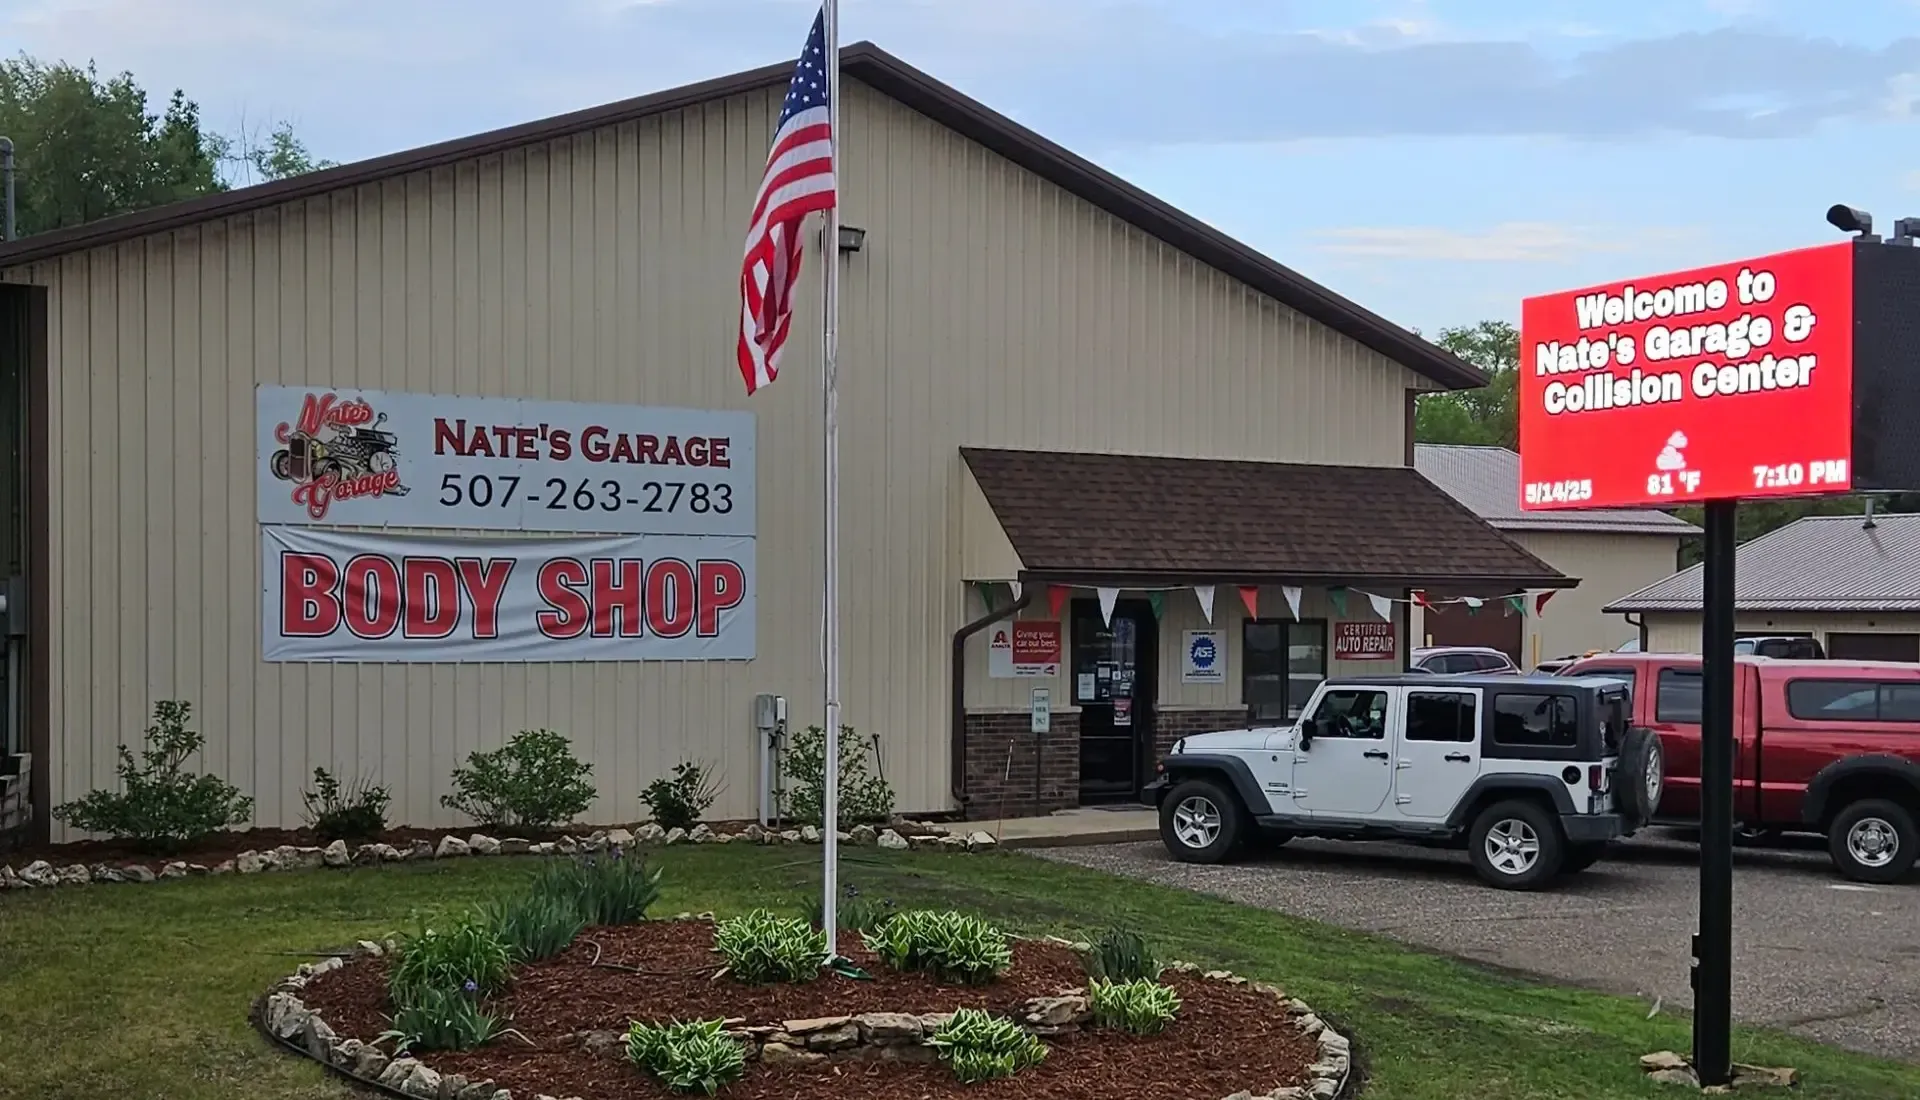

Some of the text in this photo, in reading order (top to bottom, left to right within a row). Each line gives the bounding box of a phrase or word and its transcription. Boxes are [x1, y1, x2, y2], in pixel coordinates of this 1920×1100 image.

[1576, 267, 1776, 330] Welcome to
[1536, 304, 1816, 376] Nate's Garage &
[1544, 354, 1816, 415] Collision Center
[1647, 475, 1673, 495] 81
[1753, 460, 1847, 488] 7:10 PM
[291, 467, 400, 521] Garage
[439, 474, 734, 515] 507-263-2783
[1525, 479, 1592, 504] 5/14/25
[280, 550, 746, 639] BODY SHOP
[1039, 632, 1055, 640] your
[1343, 624, 1387, 635] CERTIFIED
[1193, 647, 1213, 658] ASE
[1336, 637, 1394, 652] AUTO REPAIR
